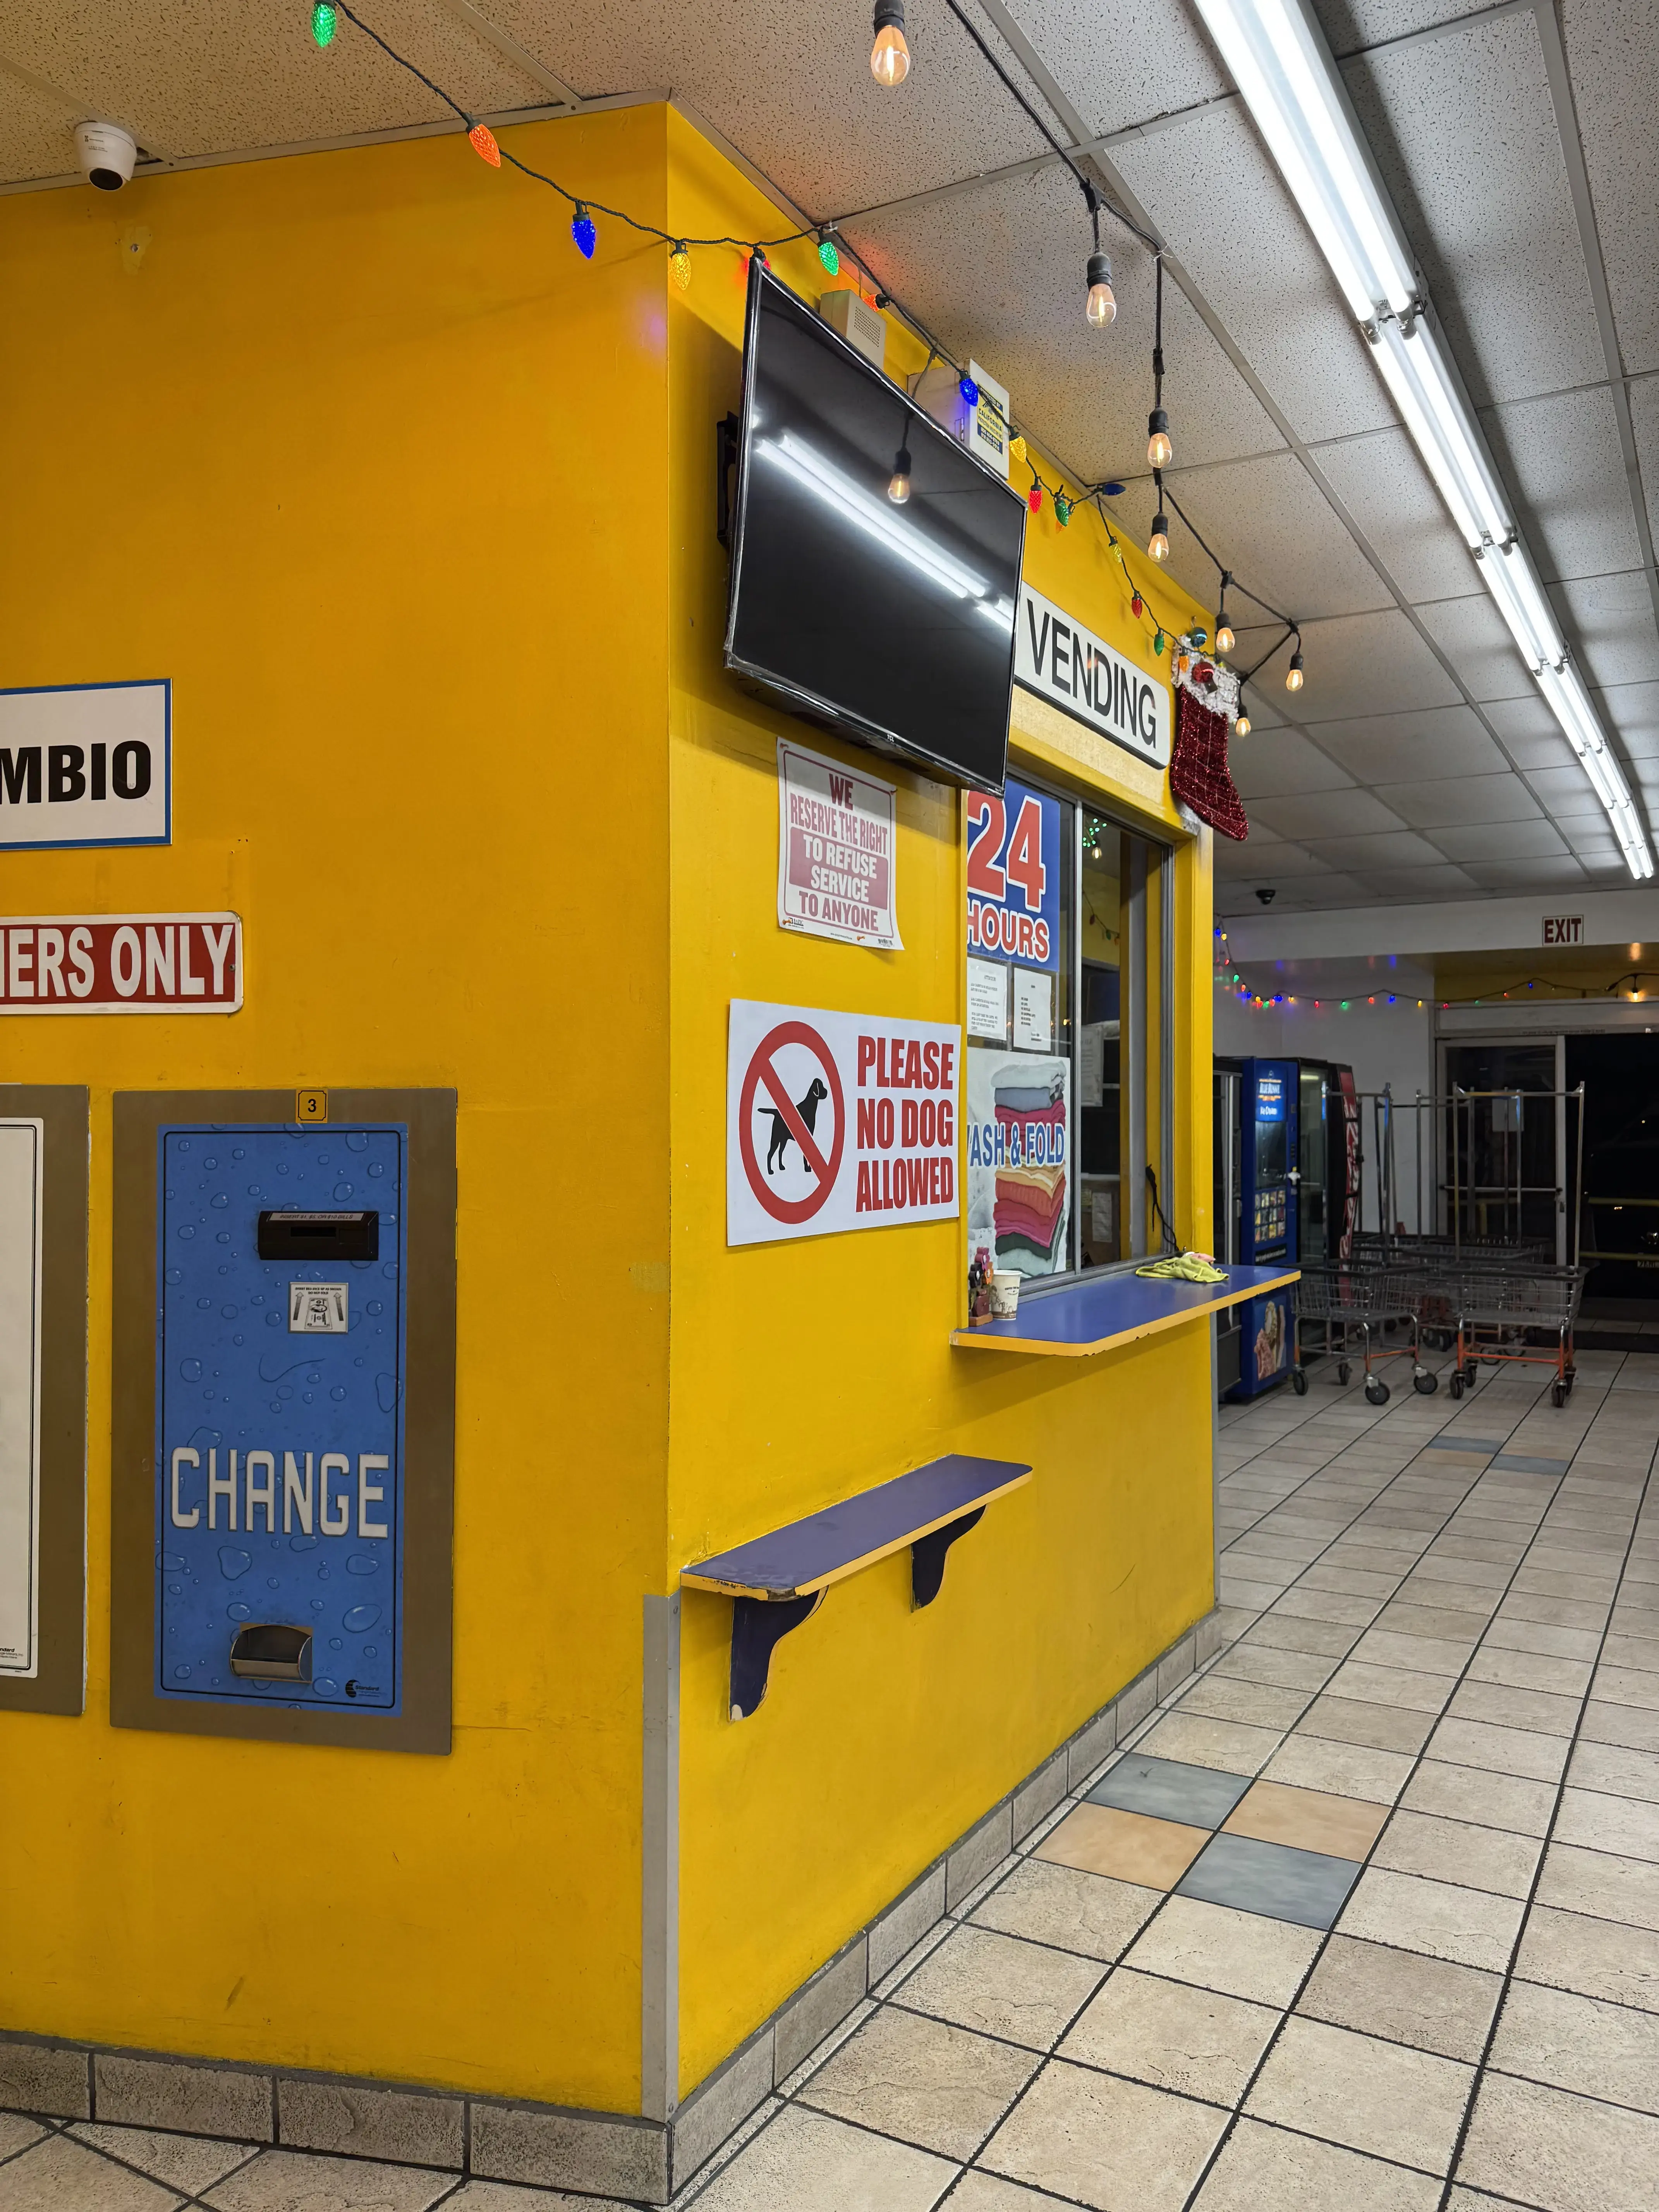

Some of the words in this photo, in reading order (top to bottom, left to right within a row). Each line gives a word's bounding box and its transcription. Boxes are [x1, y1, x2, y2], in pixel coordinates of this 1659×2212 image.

[979, 408, 1002, 433] CALIFORNIA
[1027, 598, 1156, 749] VENDING
[0, 740, 151, 805] MBIO
[829, 773, 853, 811] WE
[790, 792, 837, 838] RESERVE
[839, 811, 858, 845] THE
[860, 817, 888, 855] RIGHT
[803, 834, 823, 862] TO
[826, 842, 877, 879] REFUSE
[967, 790, 1045, 912] 24
[811, 865, 869, 903] SERVICE
[799, 891, 818, 917] TO
[822, 897, 878, 931] ANYONE
[1544, 918, 1582, 943] EXIT
[0, 926, 95, 998] ERS
[110, 925, 234, 997] ONLY
[857, 1035, 954, 1090] PLEASE
[307, 1098, 317, 1113] 3
[857, 1097, 894, 1149] NO
[902, 1099, 953, 1148] DOG
[1012, 1124, 1020, 1167] &
[1027, 1124, 1064, 1163] FOLD
[856, 1156, 953, 1213] ALLOWED
[171, 1446, 389, 1539] CHANGE
